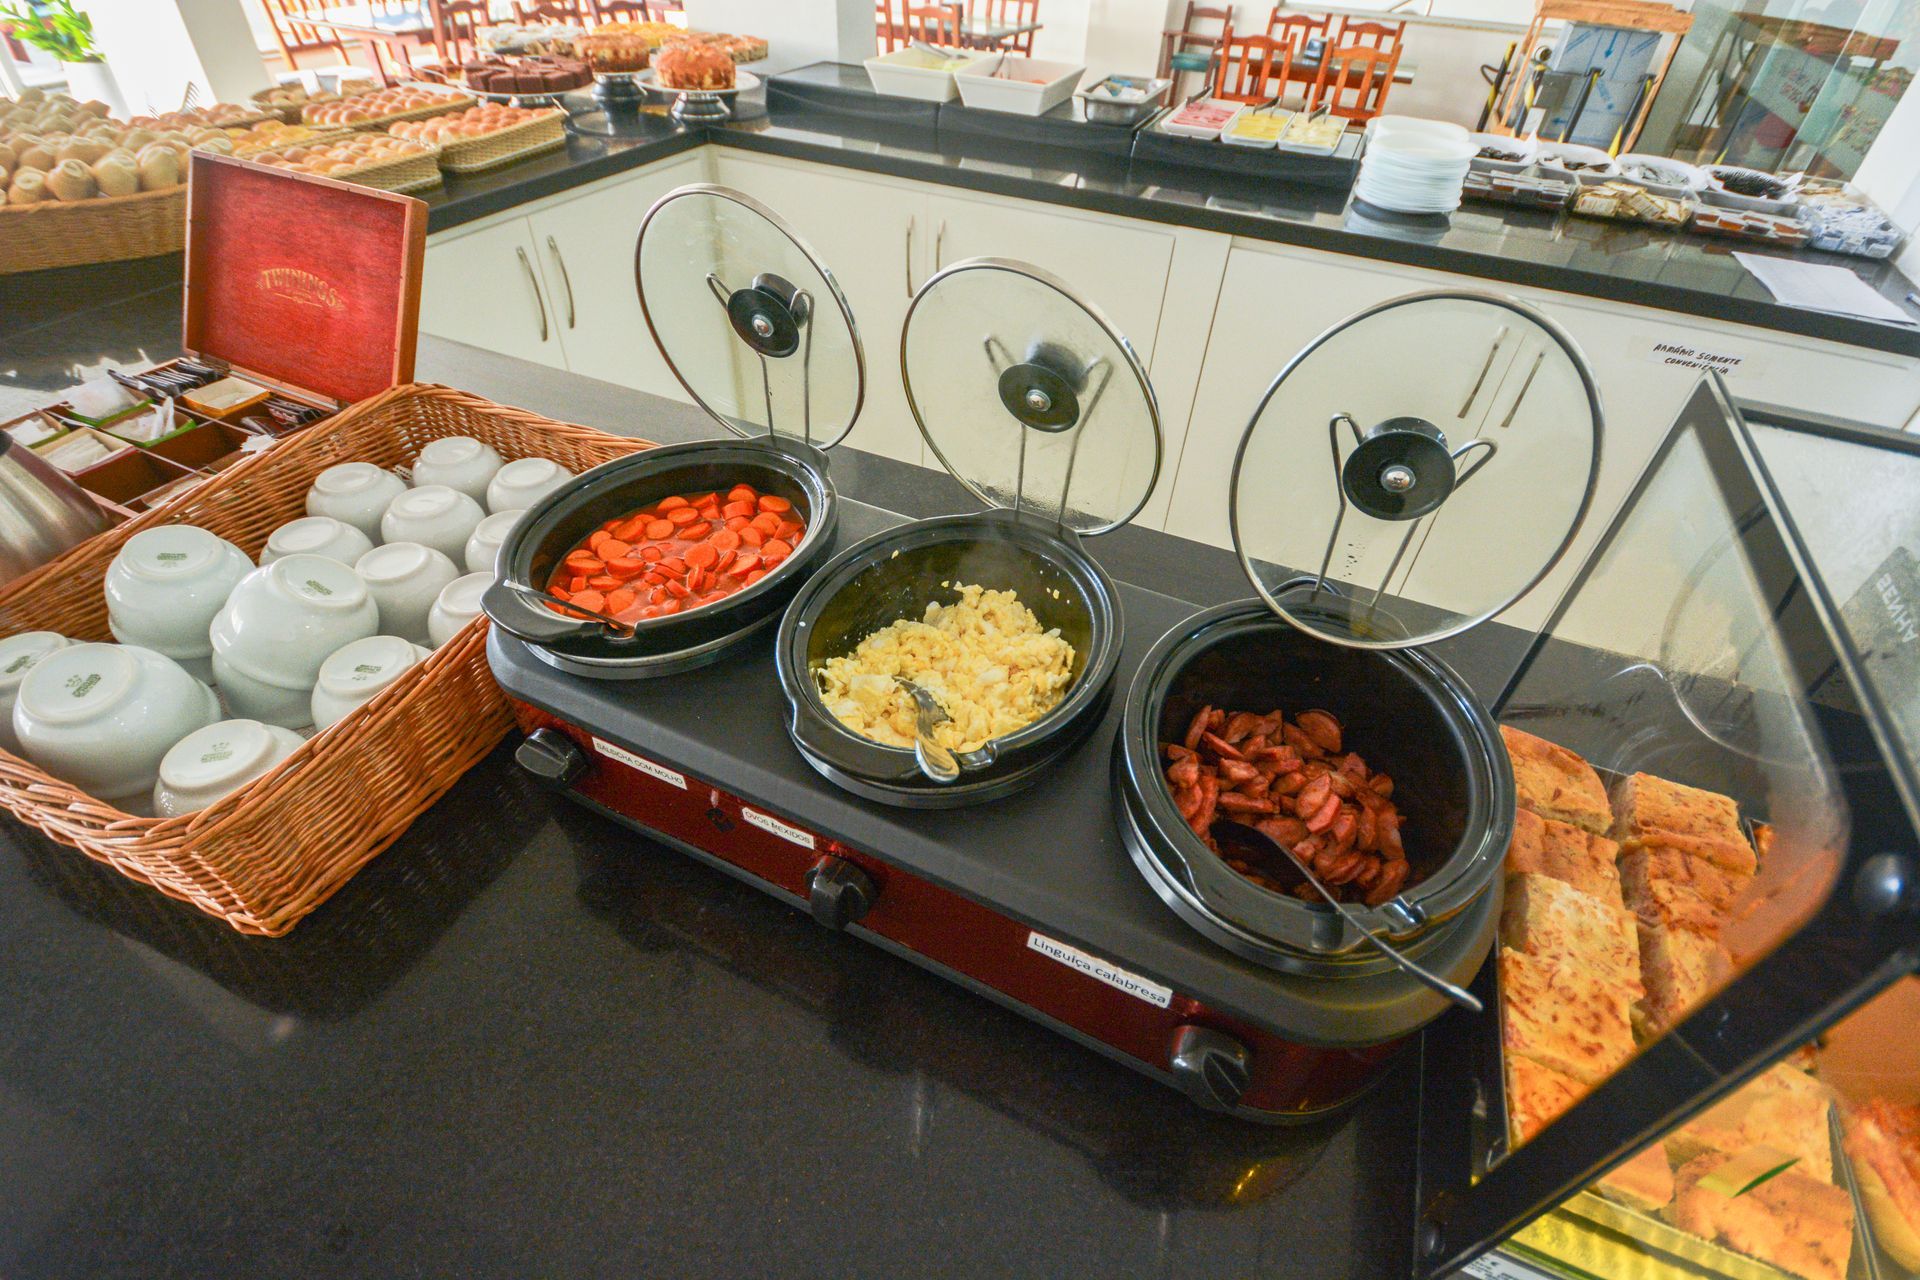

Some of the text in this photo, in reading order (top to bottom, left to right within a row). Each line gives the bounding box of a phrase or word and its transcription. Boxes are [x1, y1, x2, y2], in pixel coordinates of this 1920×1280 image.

[262, 268, 337, 307] TWININGS
[1696, 352, 1742, 365] SOMENTE
[634, 758, 653, 771] COM
[654, 767, 684, 785] MOLHO
[744, 810, 811, 844] OVOS MEXIDOS
[1033, 937, 1167, 1004] Linguiça calabresa
